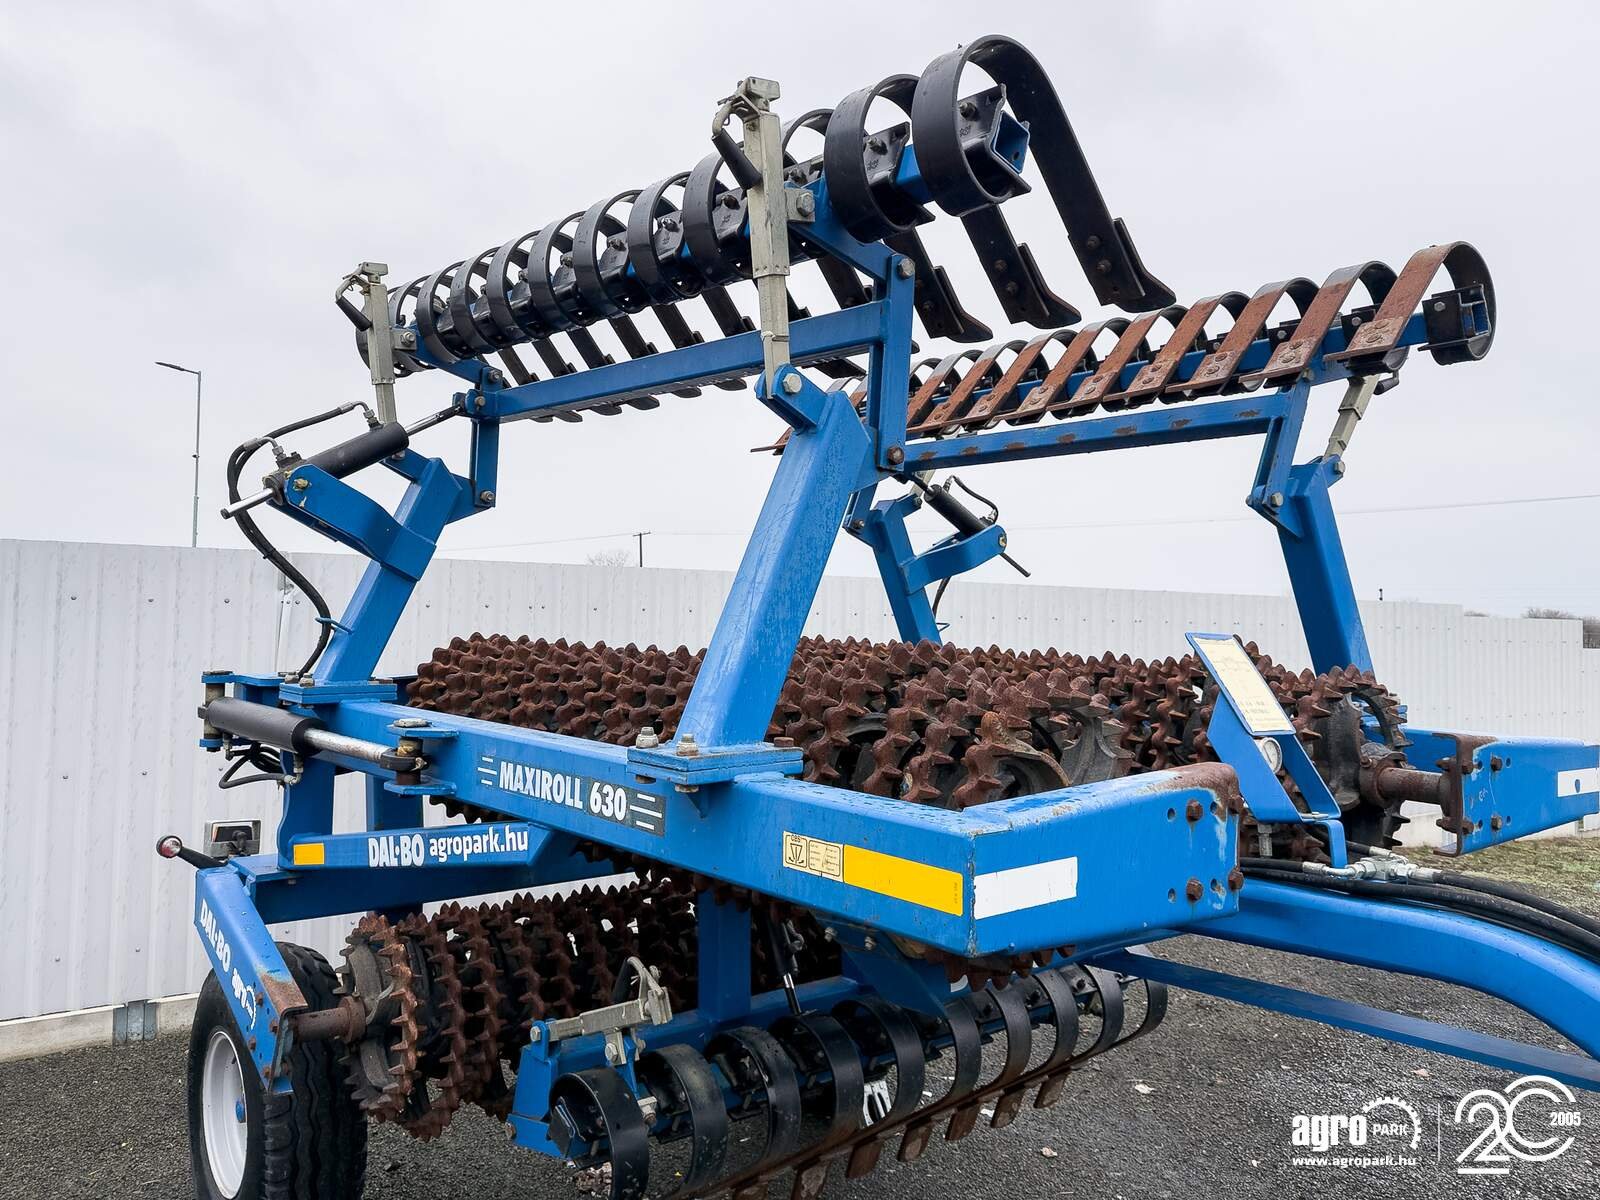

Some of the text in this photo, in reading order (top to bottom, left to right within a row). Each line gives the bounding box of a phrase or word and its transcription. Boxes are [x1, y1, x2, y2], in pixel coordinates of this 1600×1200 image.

[499, 761, 627, 821] MAXIROLL 630
[429, 825, 529, 863] agropark.hu
